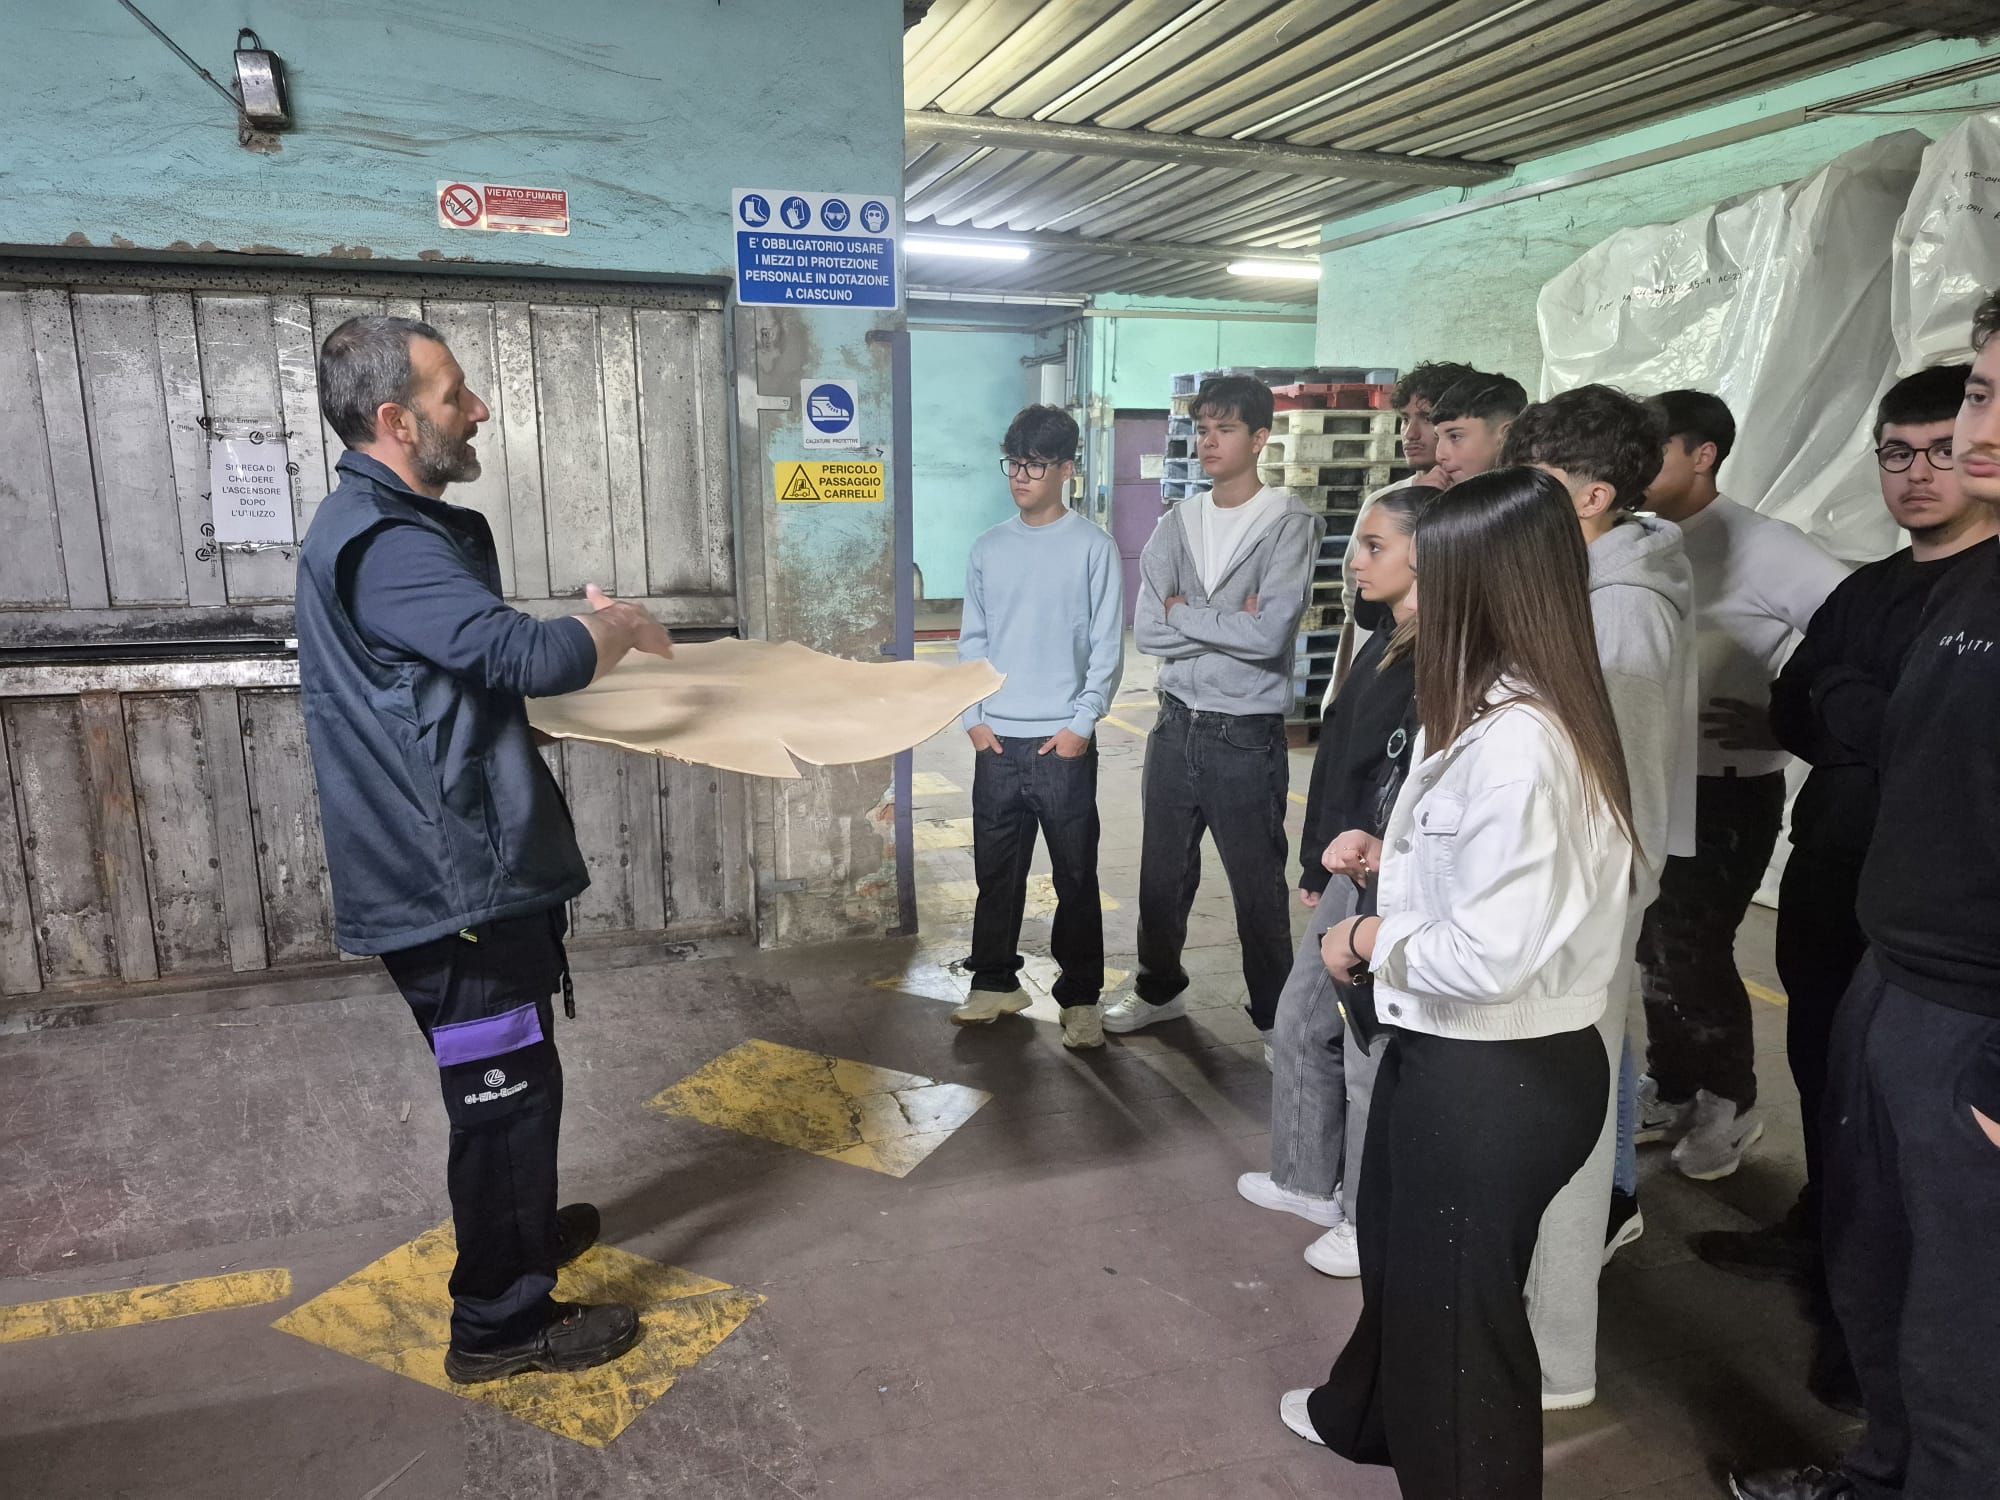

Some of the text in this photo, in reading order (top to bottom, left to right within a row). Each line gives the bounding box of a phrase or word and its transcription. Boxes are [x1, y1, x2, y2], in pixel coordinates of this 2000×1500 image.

[486, 188, 564, 201] VIETATO FUMARE
[749, 237, 884, 254] E' OBBLIGATORIO USARE
[755, 253, 879, 270] I MEZZI DI PROTEZIONE
[745, 269, 890, 287] PERSONALE IN DOTAZIONE
[785, 287, 853, 301] A CIASCUNO
[266, 464, 276, 472] DI
[822, 464, 878, 474] PERICOLO
[228, 475, 275, 484] CHIUDERE
[819, 477, 881, 487] PASSAGGIO
[222, 486, 281, 495] L'ASCENSORE
[823, 489, 877, 499] CARRELLI
[240, 498, 266, 506] DOPO
